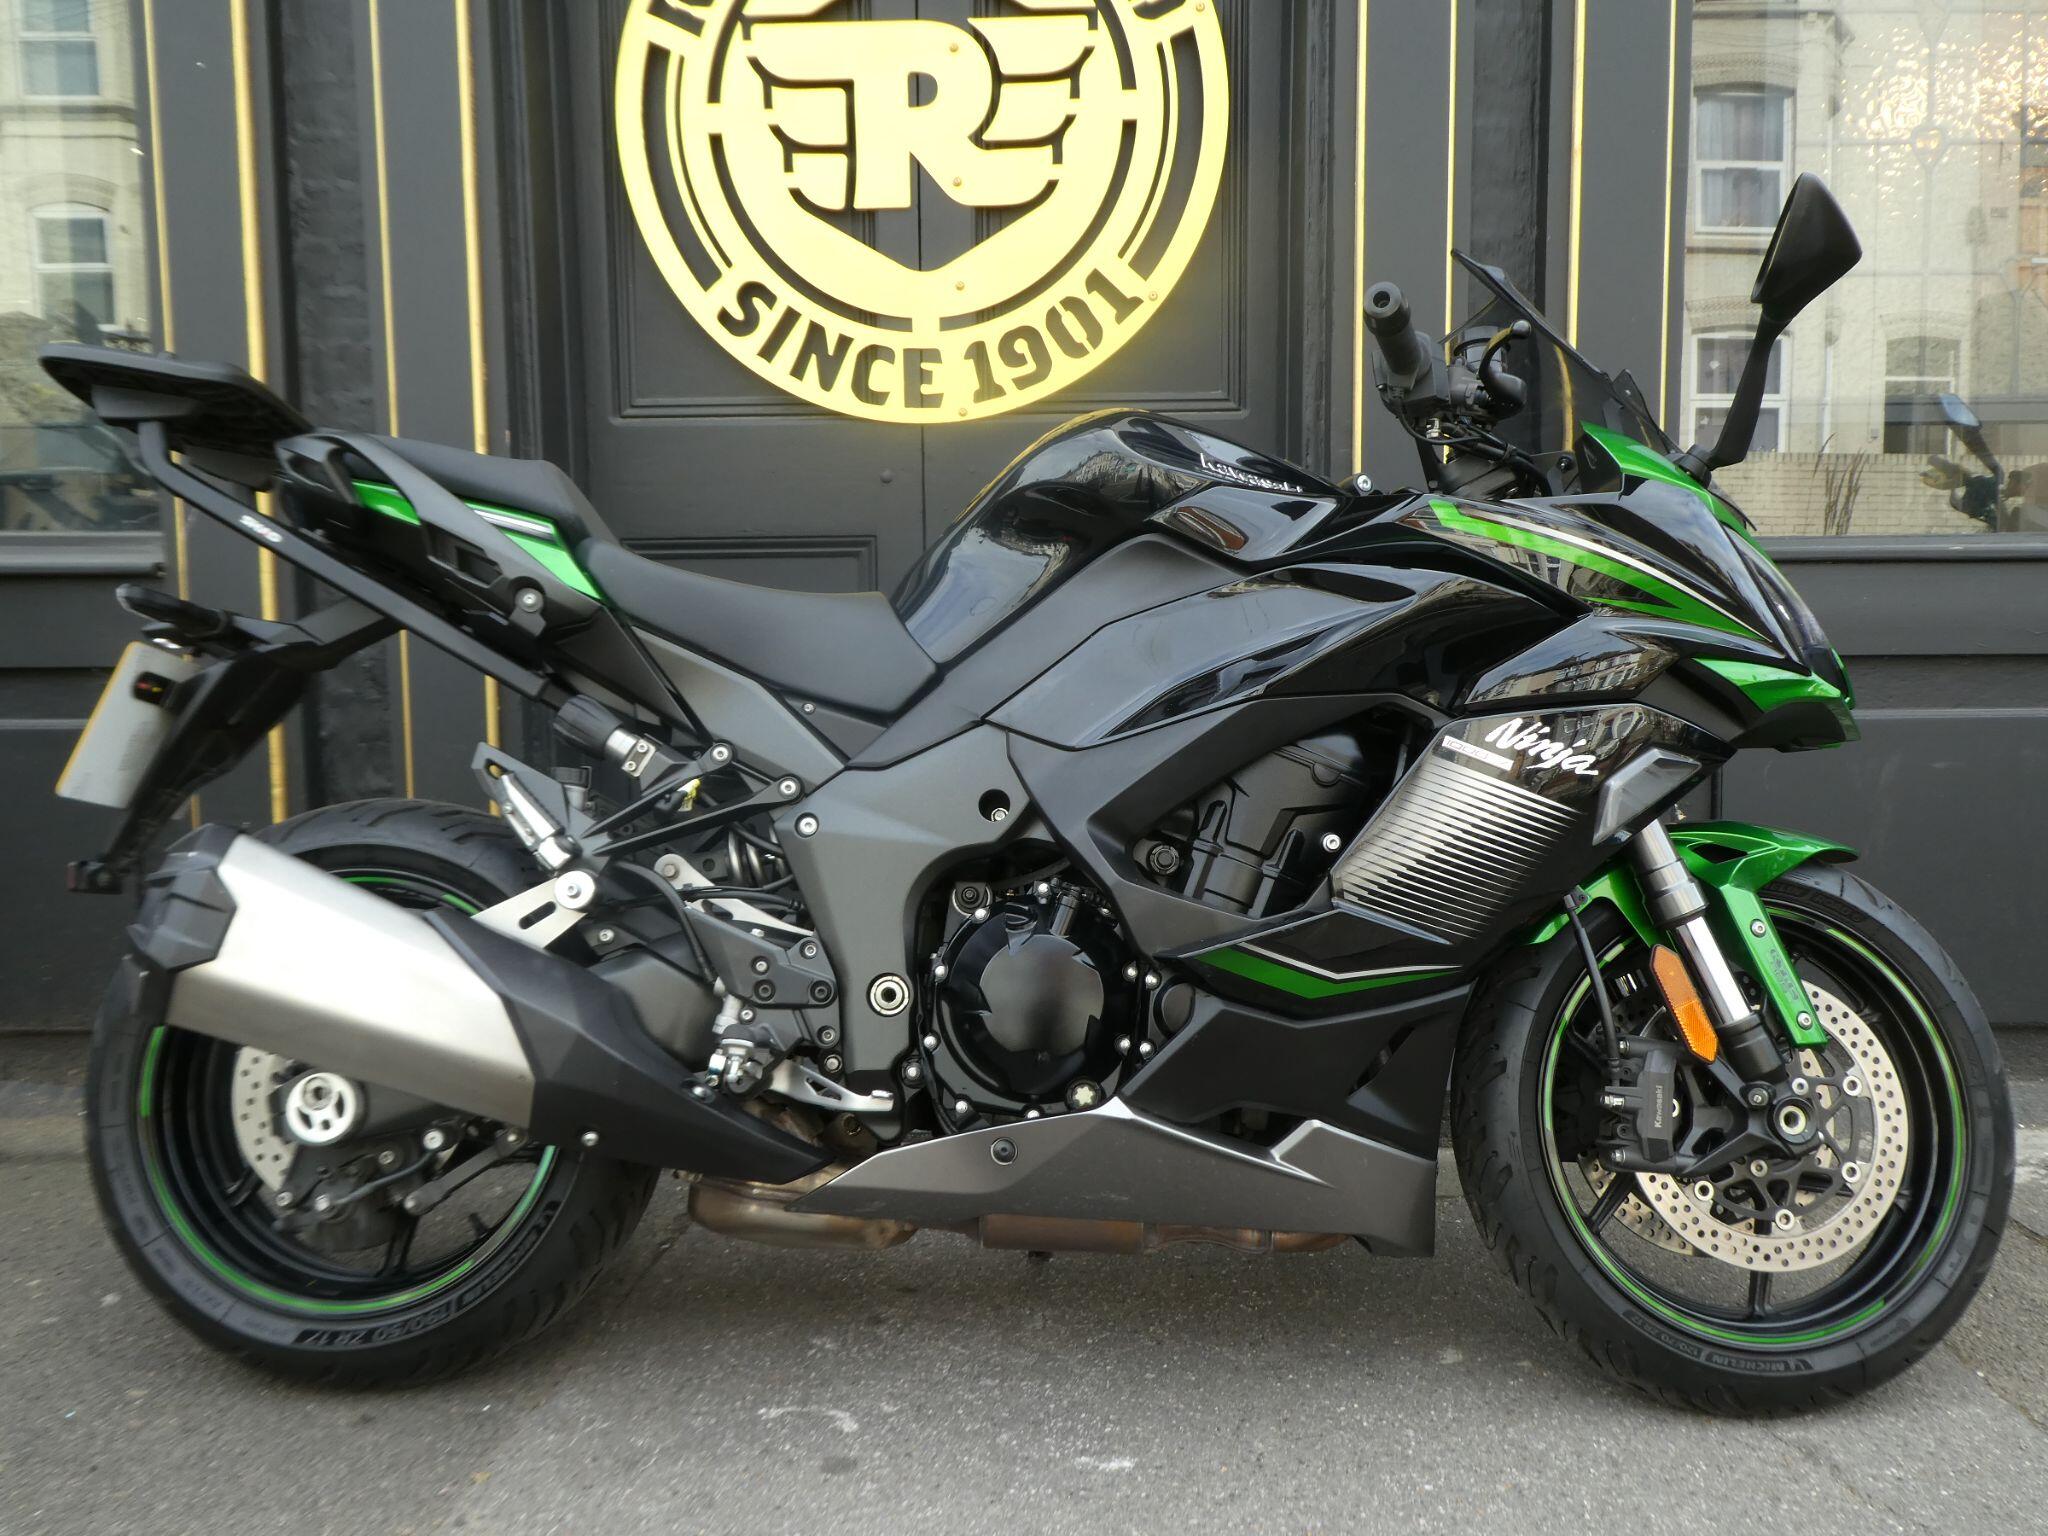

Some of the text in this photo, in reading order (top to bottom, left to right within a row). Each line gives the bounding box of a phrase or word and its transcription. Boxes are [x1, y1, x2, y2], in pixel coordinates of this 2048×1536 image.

[717, 267, 1144, 409] SINCE 1901
[1485, 717, 1599, 776] Ninja
[1654, 1084, 1664, 1128] Kawasaki
[1712, 1353, 1785, 1373] MICHELIN
